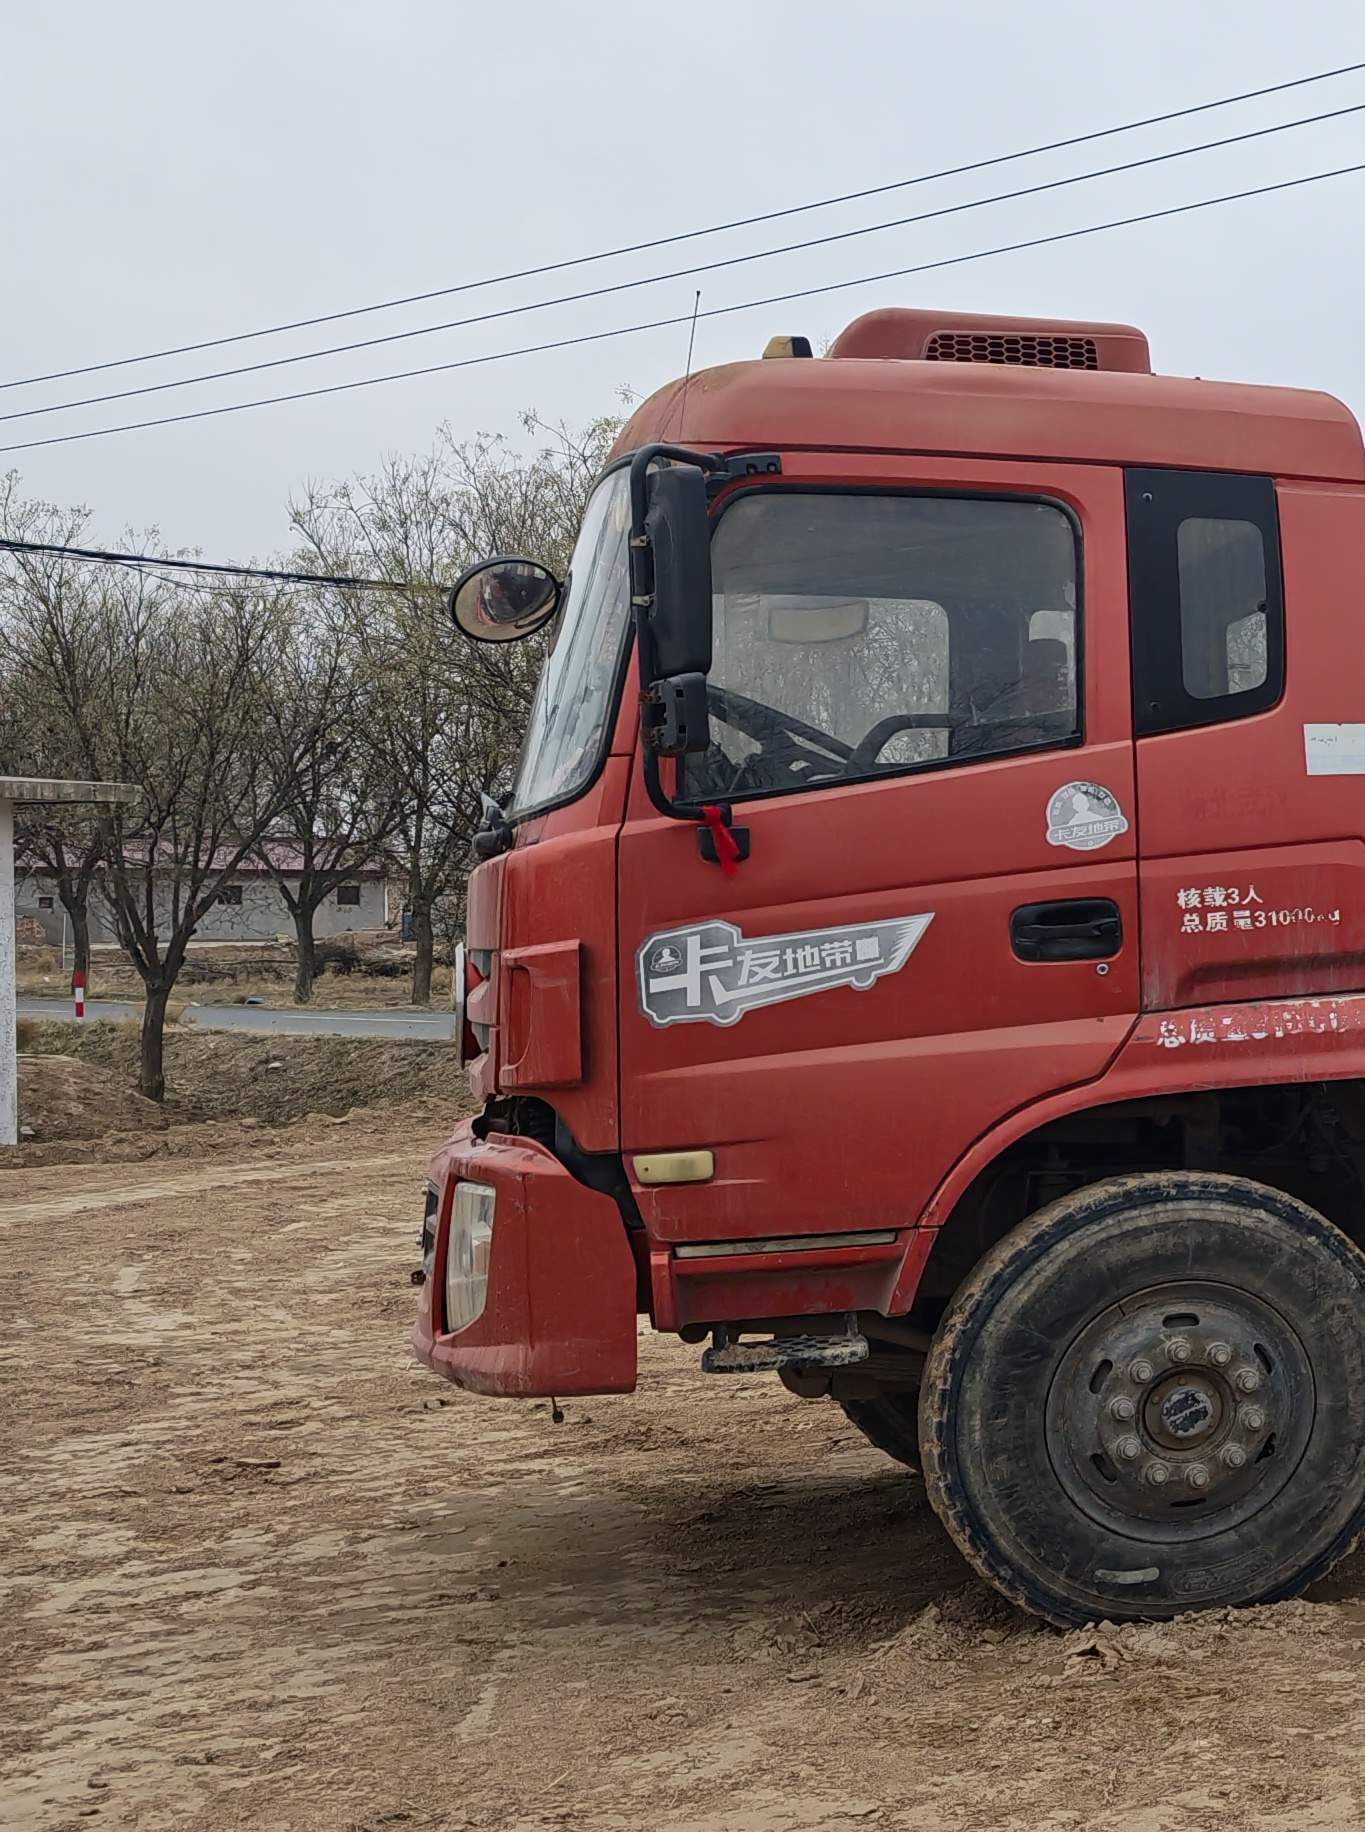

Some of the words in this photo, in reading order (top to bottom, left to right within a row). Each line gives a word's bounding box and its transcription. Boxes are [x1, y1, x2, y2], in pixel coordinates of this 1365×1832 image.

[1177, 884, 1264, 909] 核载3人
[650, 934, 884, 1007] 卡友地带
